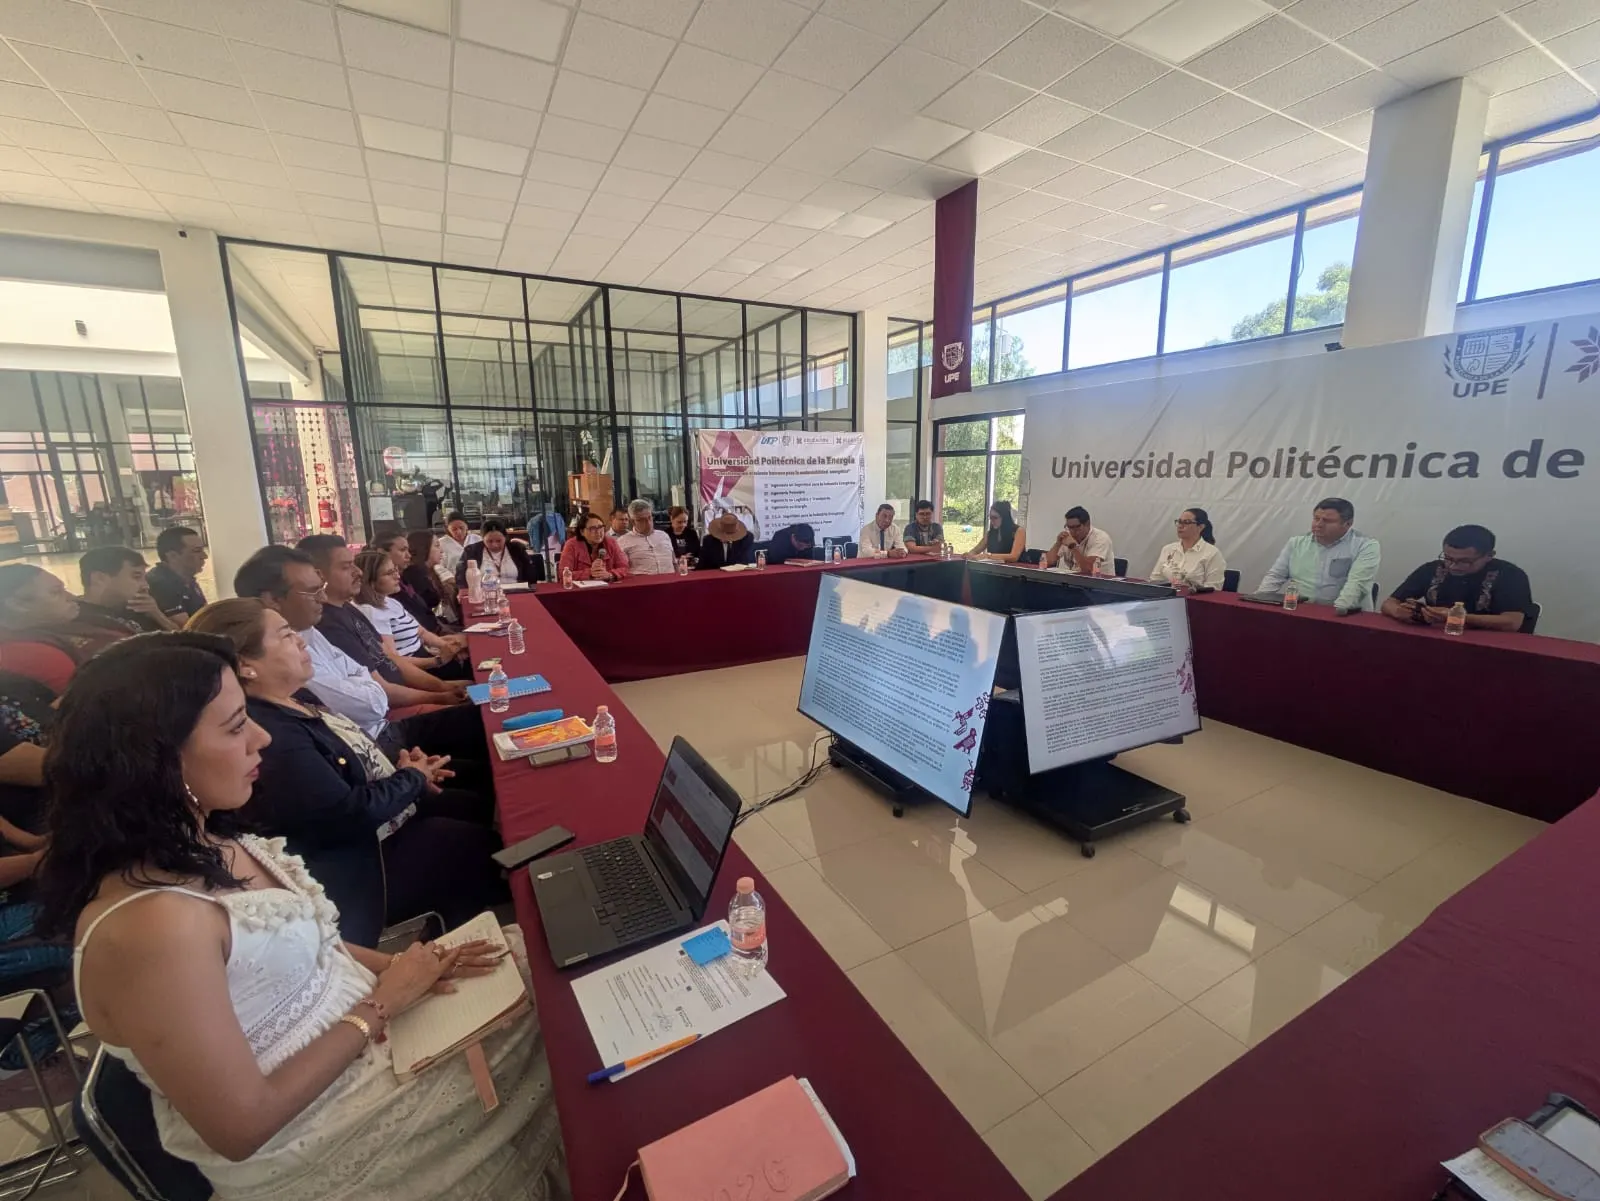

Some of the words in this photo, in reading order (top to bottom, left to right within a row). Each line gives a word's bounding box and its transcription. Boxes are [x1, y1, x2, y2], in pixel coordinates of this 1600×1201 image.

[944, 371, 961, 384] UPE
[1453, 378, 1510, 398] UPE
[707, 456, 759, 466] Universidad
[761, 455, 806, 466] Politécnica
[807, 455, 817, 465] de
[818, 455, 826, 465] la
[827, 454, 855, 467] Energía
[1051, 450, 1215, 479] Universidad
[1227, 441, 1479, 480] Politécnica
[1502, 438, 1585, 480] de
